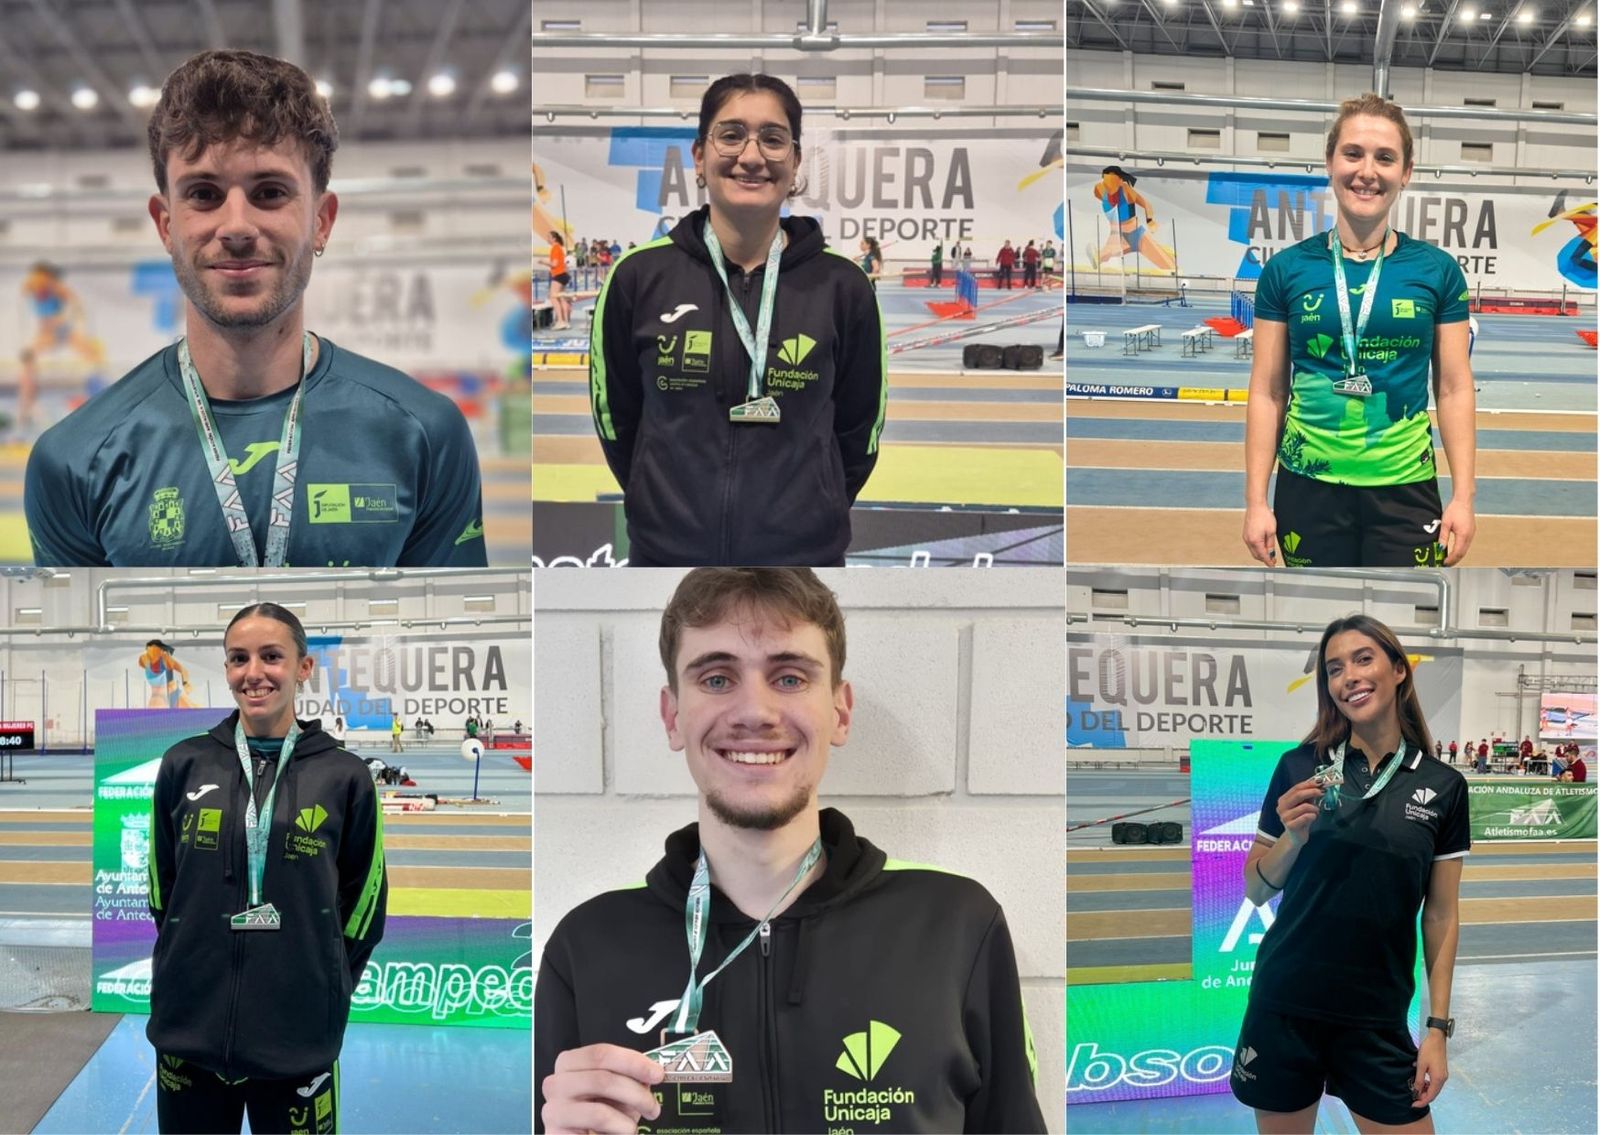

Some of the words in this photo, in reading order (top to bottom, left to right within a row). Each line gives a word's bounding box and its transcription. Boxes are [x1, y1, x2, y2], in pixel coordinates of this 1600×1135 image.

[840, 217, 975, 241] DEPORTE
[767, 367, 819, 382] Fundación
[767, 376, 806, 391] Unicaja
[1066, 383, 1106, 393] PALOMA
[1109, 386, 1154, 396] ROMERO
[1068, 648, 1253, 708] EQUERA
[358, 699, 398, 716] DEL
[404, 697, 508, 715] DEPORTE
[1080, 710, 1130, 731] DEL
[1136, 711, 1253, 734] DEPORTE
[1496, 786, 1541, 796] ANDALUZA
[1542, 787, 1554, 796] DE
[1484, 827, 1558, 837] Atletismofaa.es
[96, 883, 112, 894] de
[96, 910, 112, 921] de
[1201, 975, 1222, 989] de
[823, 1087, 915, 1105] Fundación
[824, 1104, 891, 1124] Unicaja
